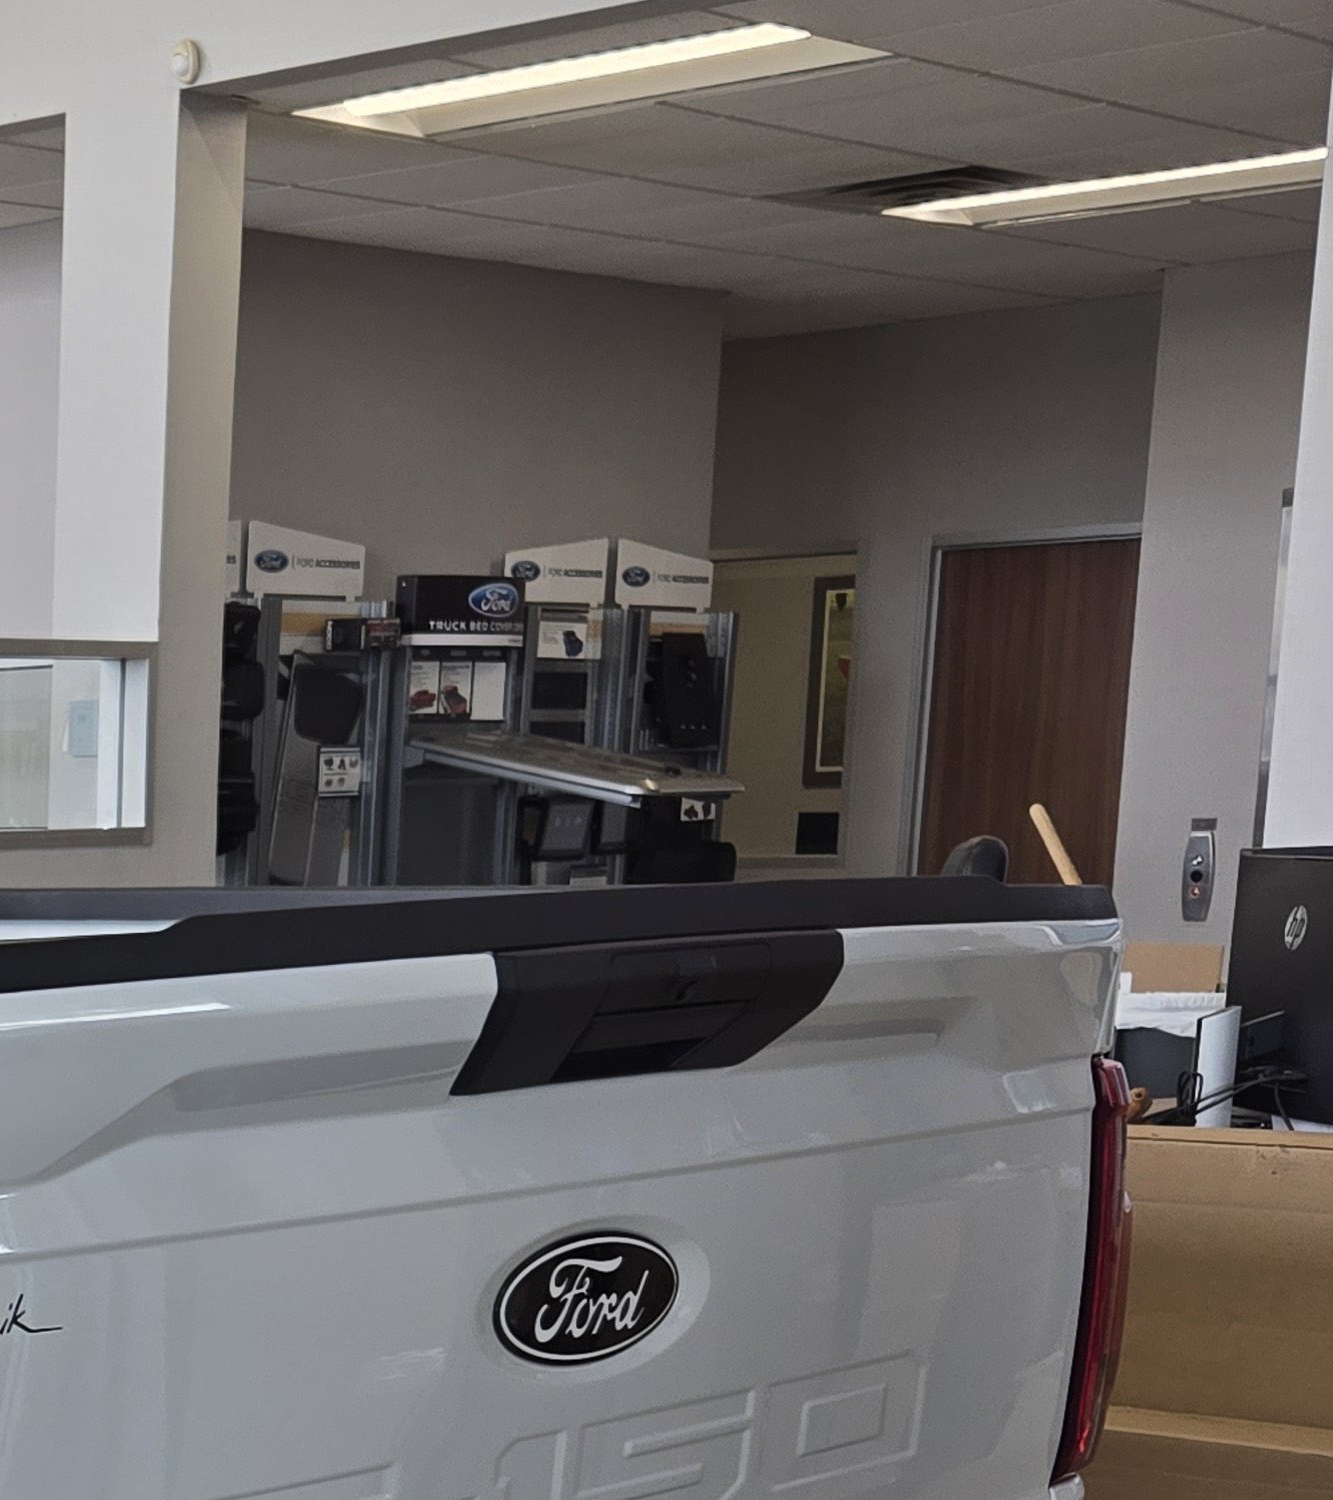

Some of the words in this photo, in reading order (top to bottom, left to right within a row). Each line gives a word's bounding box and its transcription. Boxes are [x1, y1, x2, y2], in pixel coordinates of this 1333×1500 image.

[481, 588, 513, 612] Ford
[429, 620, 466, 632] TRUCK
[534, 1256, 649, 1343] Ford
